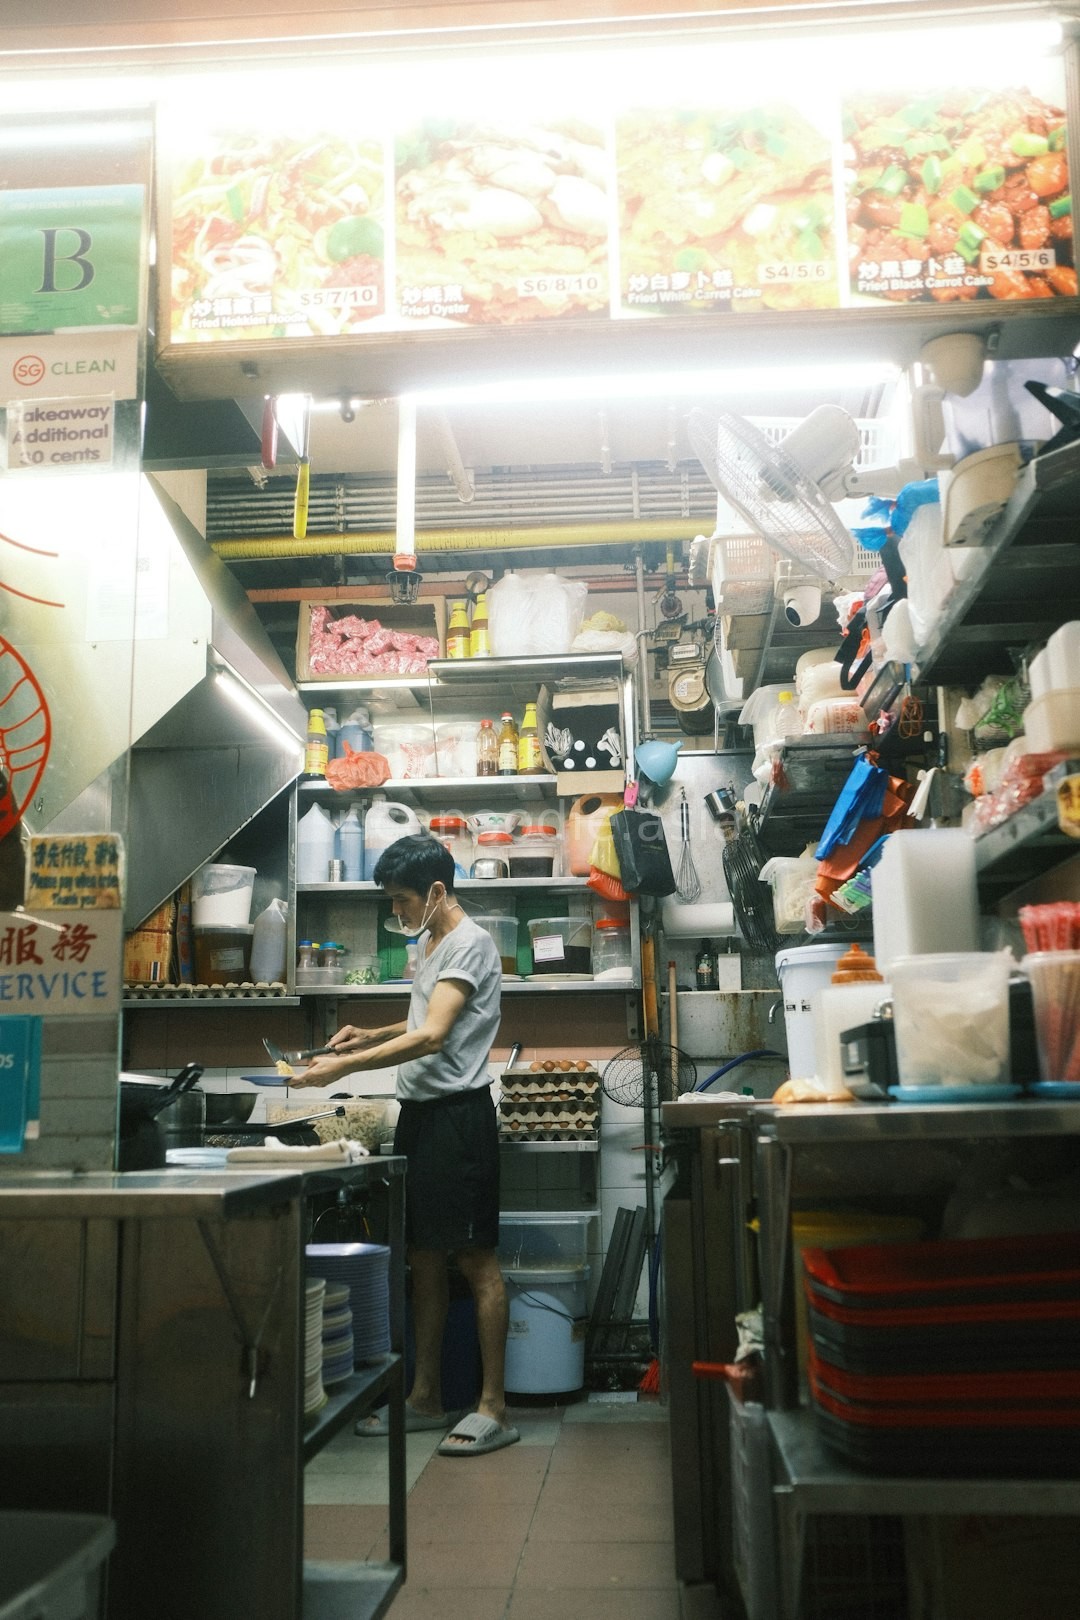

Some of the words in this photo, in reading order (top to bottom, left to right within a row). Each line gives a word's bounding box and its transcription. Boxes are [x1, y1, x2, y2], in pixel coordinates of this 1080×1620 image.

[33, 226, 96, 294] B
[987, 252, 1049, 269] $4/5/6
[858, 280, 889, 292] Fried
[890, 278, 924, 290] Black
[925, 277, 963, 289] Carrot
[964, 275, 995, 287] Cake
[300, 288, 373, 306] $5/7/10
[628, 292, 658, 304] Fried
[659, 290, 692, 303] White
[695, 288, 732, 300] Carrot
[401, 304, 431, 316] Fried
[432, 303, 471, 317] Oyster
[191, 316, 221, 329] Fried
[221, 313, 267, 328] Hokkien
[17, 363, 42, 378] SG
[51, 359, 116, 376] CLEAN
[15, 406, 110, 422] akeaway
[12, 423, 109, 444] Additional
[50, 447, 100, 463] cents
[0, 922, 97, 966] 服務
